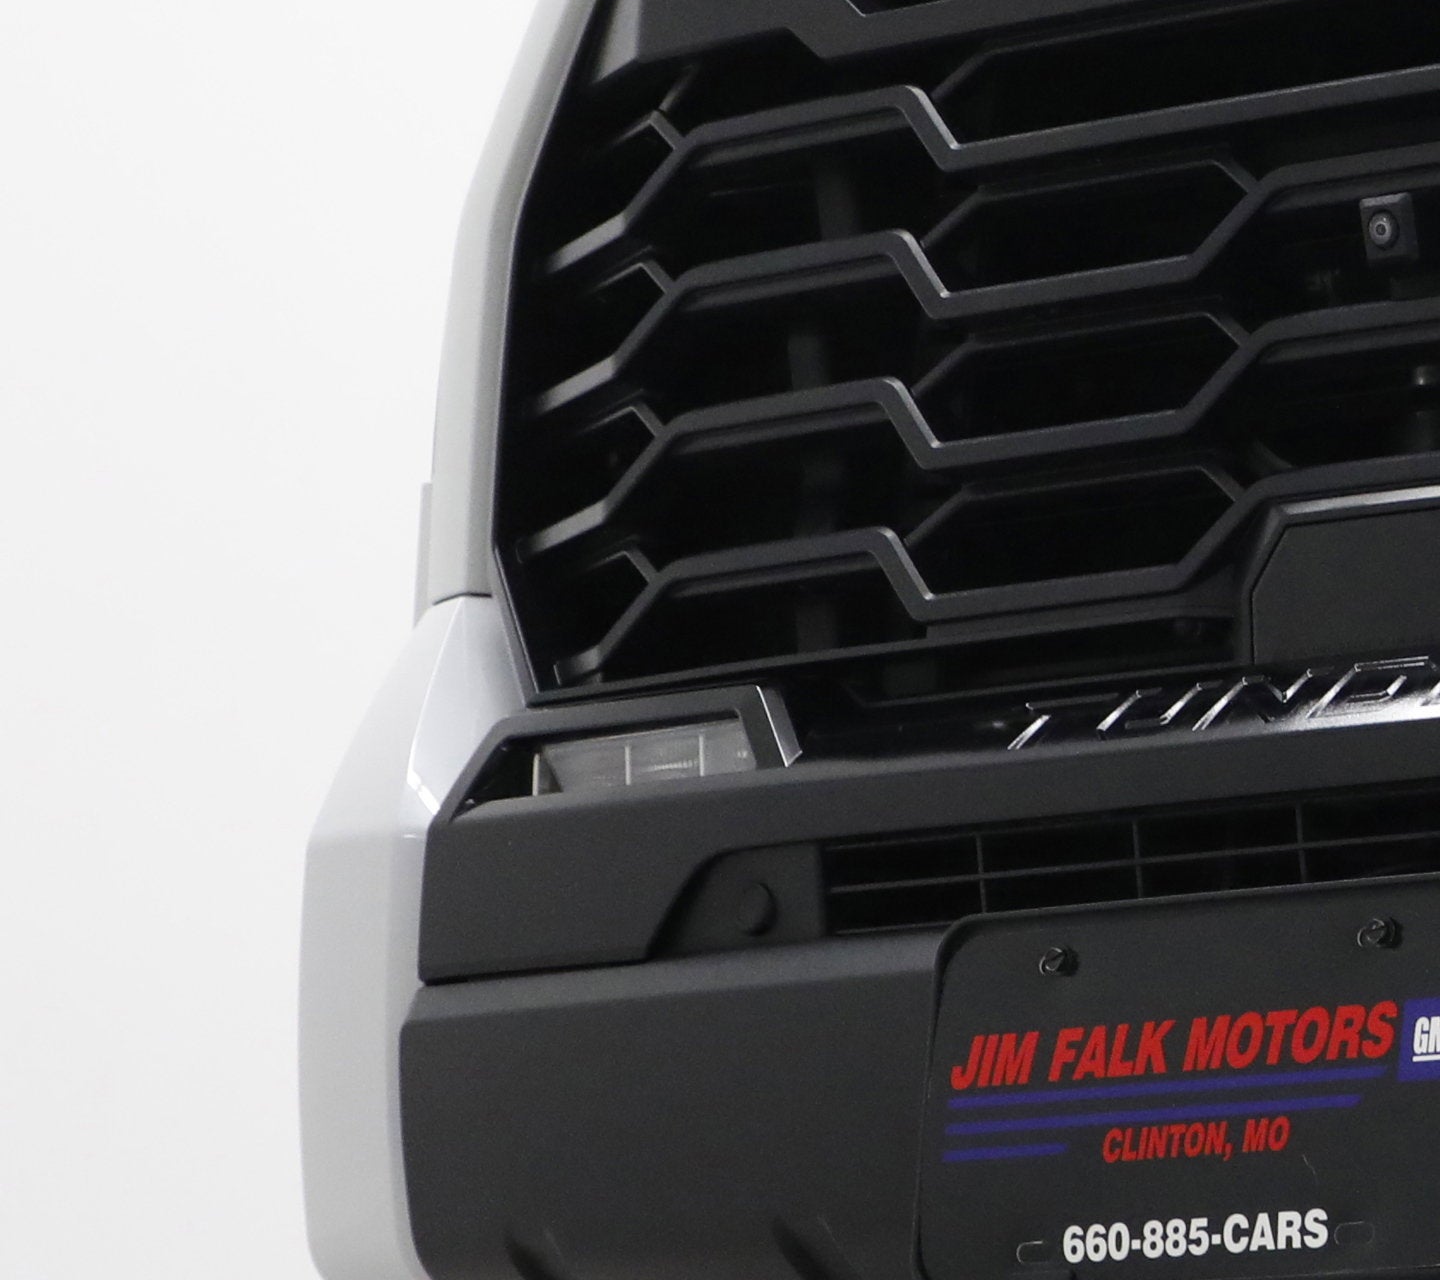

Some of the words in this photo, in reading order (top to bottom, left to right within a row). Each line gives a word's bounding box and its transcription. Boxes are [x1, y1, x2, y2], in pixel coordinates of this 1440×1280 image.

[949, 1029, 1041, 1092] JIM
[1047, 1018, 1177, 1084] FALK
[1182, 998, 1400, 1074] MOTORS
[1101, 1119, 1236, 1165] CLINTON,
[1240, 1114, 1293, 1154] MO
[1061, 1206, 1330, 1265] 660-885-CARS
